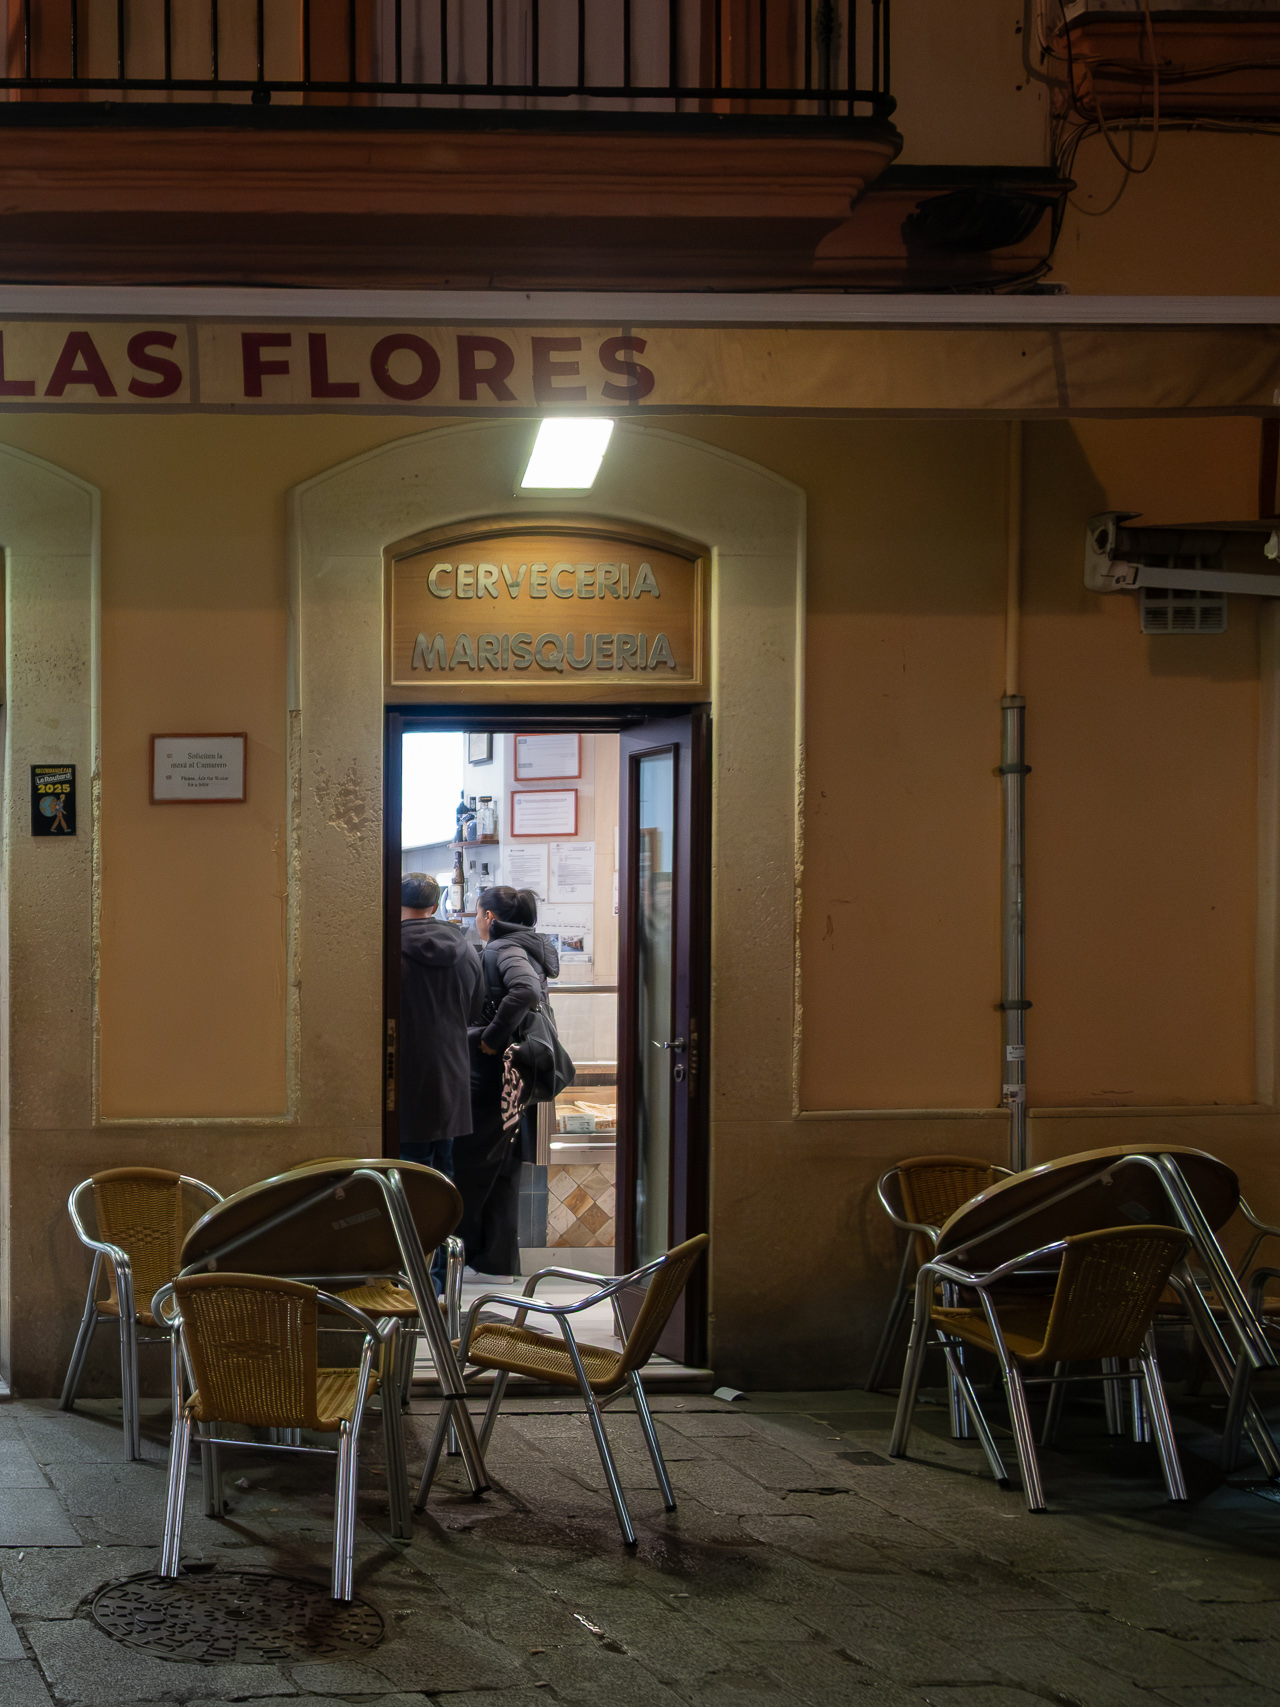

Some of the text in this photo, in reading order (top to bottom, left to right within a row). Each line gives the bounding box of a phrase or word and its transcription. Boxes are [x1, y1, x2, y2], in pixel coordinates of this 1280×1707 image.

[241, 332, 656, 402] FLORES
[428, 562, 660, 599] CERVECERIA
[411, 633, 676, 674] MARISQUERIA
[37, 783, 70, 793] 2025
